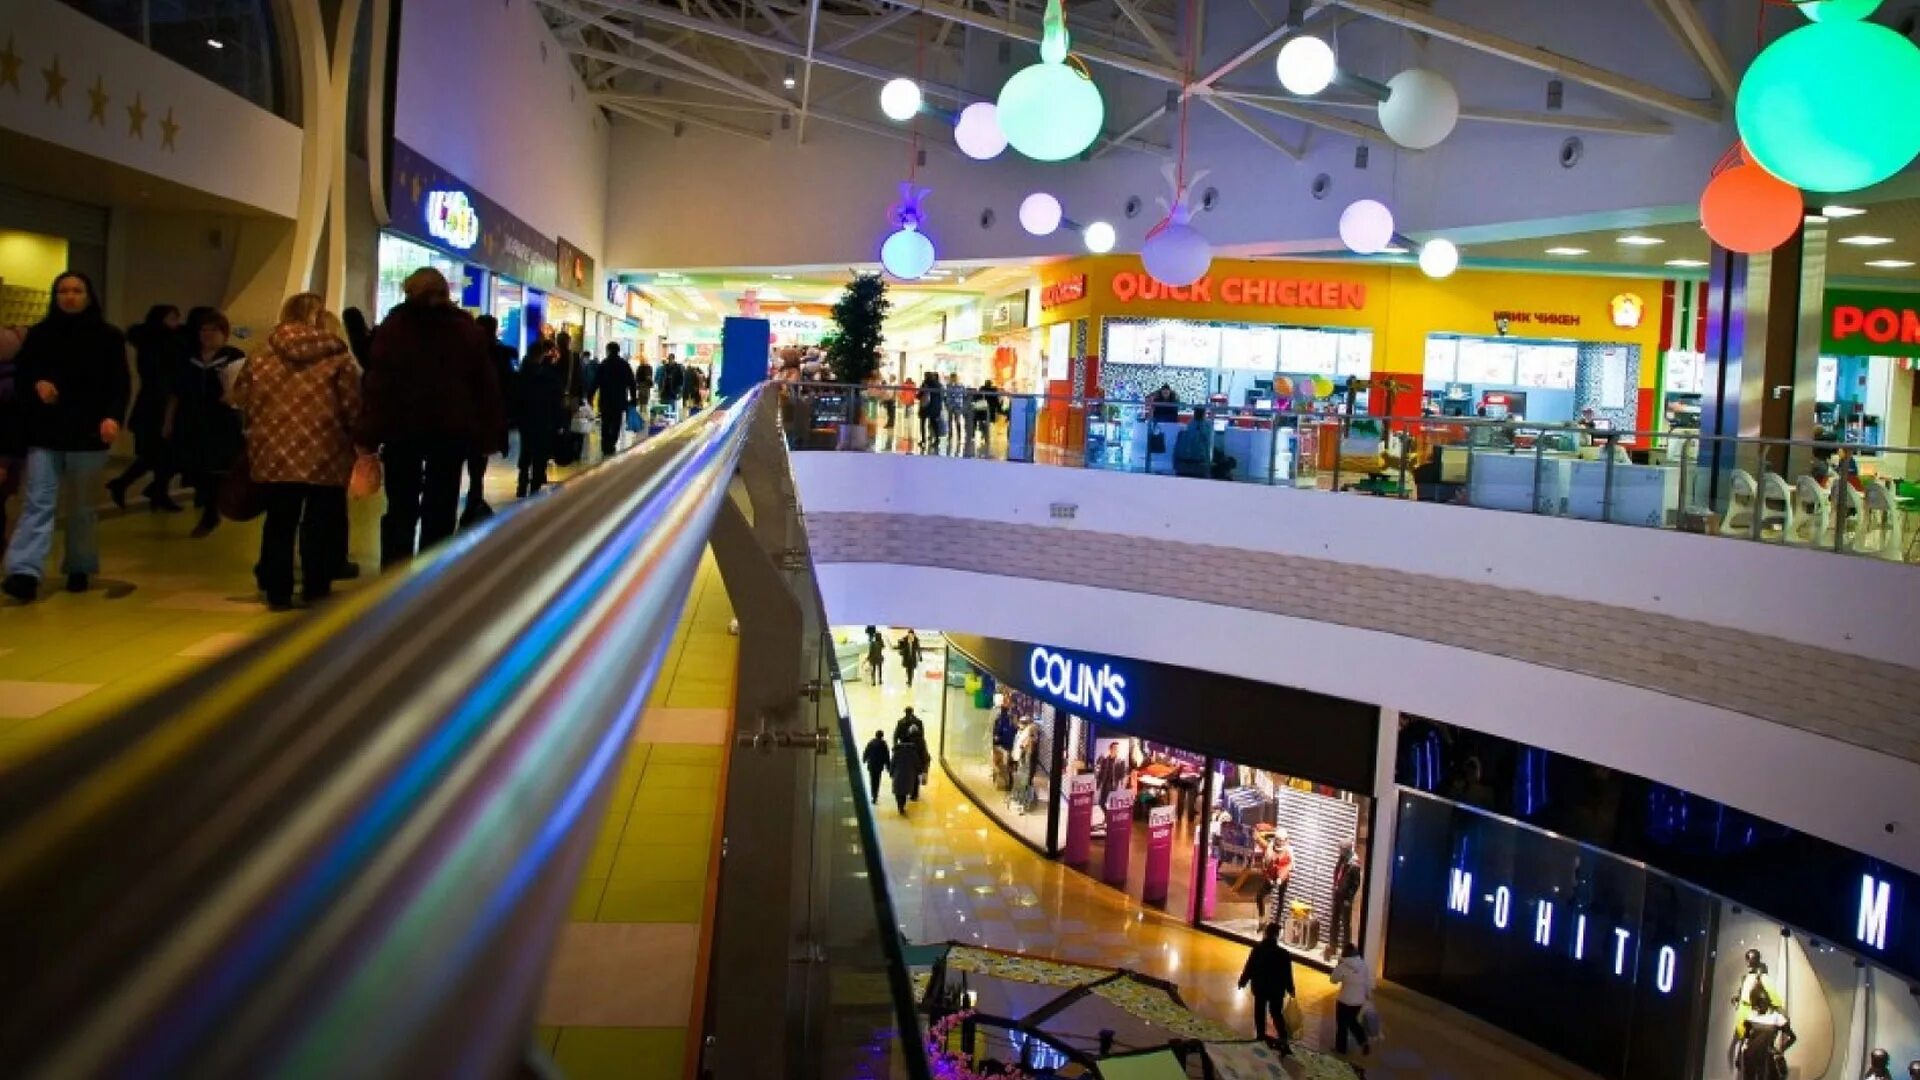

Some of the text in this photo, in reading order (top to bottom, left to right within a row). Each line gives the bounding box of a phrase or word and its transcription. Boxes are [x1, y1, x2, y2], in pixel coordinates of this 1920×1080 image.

[1111, 271, 1212, 303] QUICK
[1220, 276, 1365, 310] CHICKEN
[779, 318, 818, 330] crocs
[1534, 312, 1580, 326] ЧИКЕН
[1030, 646, 1127, 719] COLIN'S
[1449, 867, 1676, 993] MOHITO
[1857, 873, 1891, 950] M
